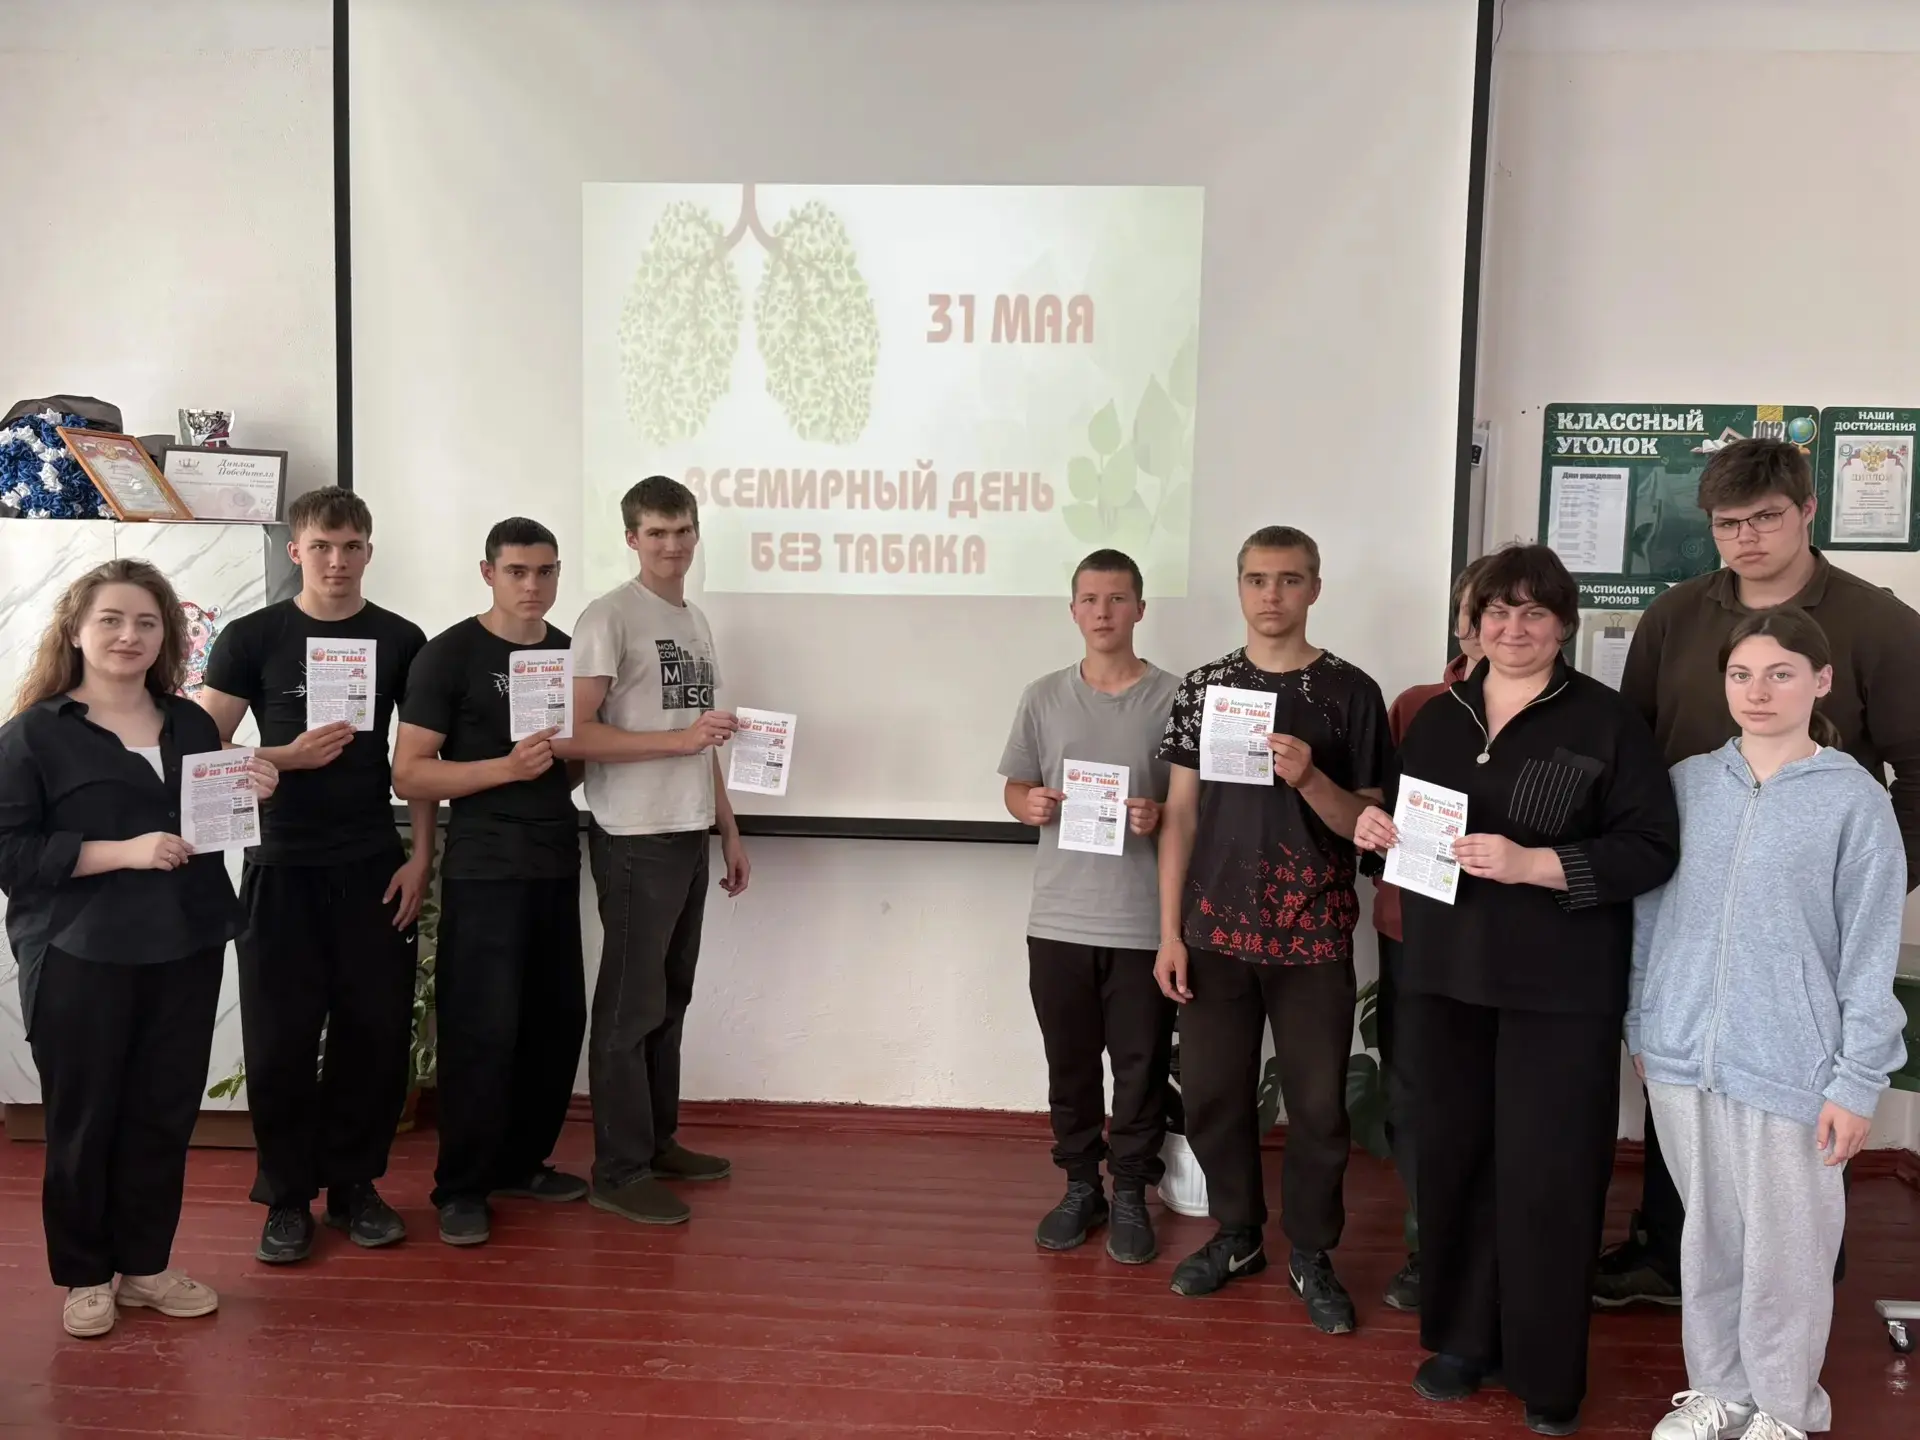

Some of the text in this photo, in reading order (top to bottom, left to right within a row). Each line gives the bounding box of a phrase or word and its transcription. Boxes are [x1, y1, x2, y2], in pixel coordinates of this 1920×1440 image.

[927, 294, 1094, 343] 31 МАЯ
[1557, 409, 1704, 431] КЛАССНЫЙ
[1858, 411, 1894, 420] НАШИ
[1834, 422, 1916, 431] ДОСТИЖЕНИЯ
[1556, 437, 1658, 455] УГОЛОК
[948, 471, 1055, 518] ДЕНЬ
[751, 532, 986, 574] БЕЗ ТАБАКА
[1579, 585, 1656, 595] РАСПИСАНИЕ
[1593, 596, 1640, 605] УРОКОВ
[657, 642, 675, 651] MOS
[660, 651, 677, 659] COW
[663, 664, 681, 684] M
[1245, 708, 1270, 718] ТАБАКА
[1438, 807, 1463, 820] ТАБАКА
